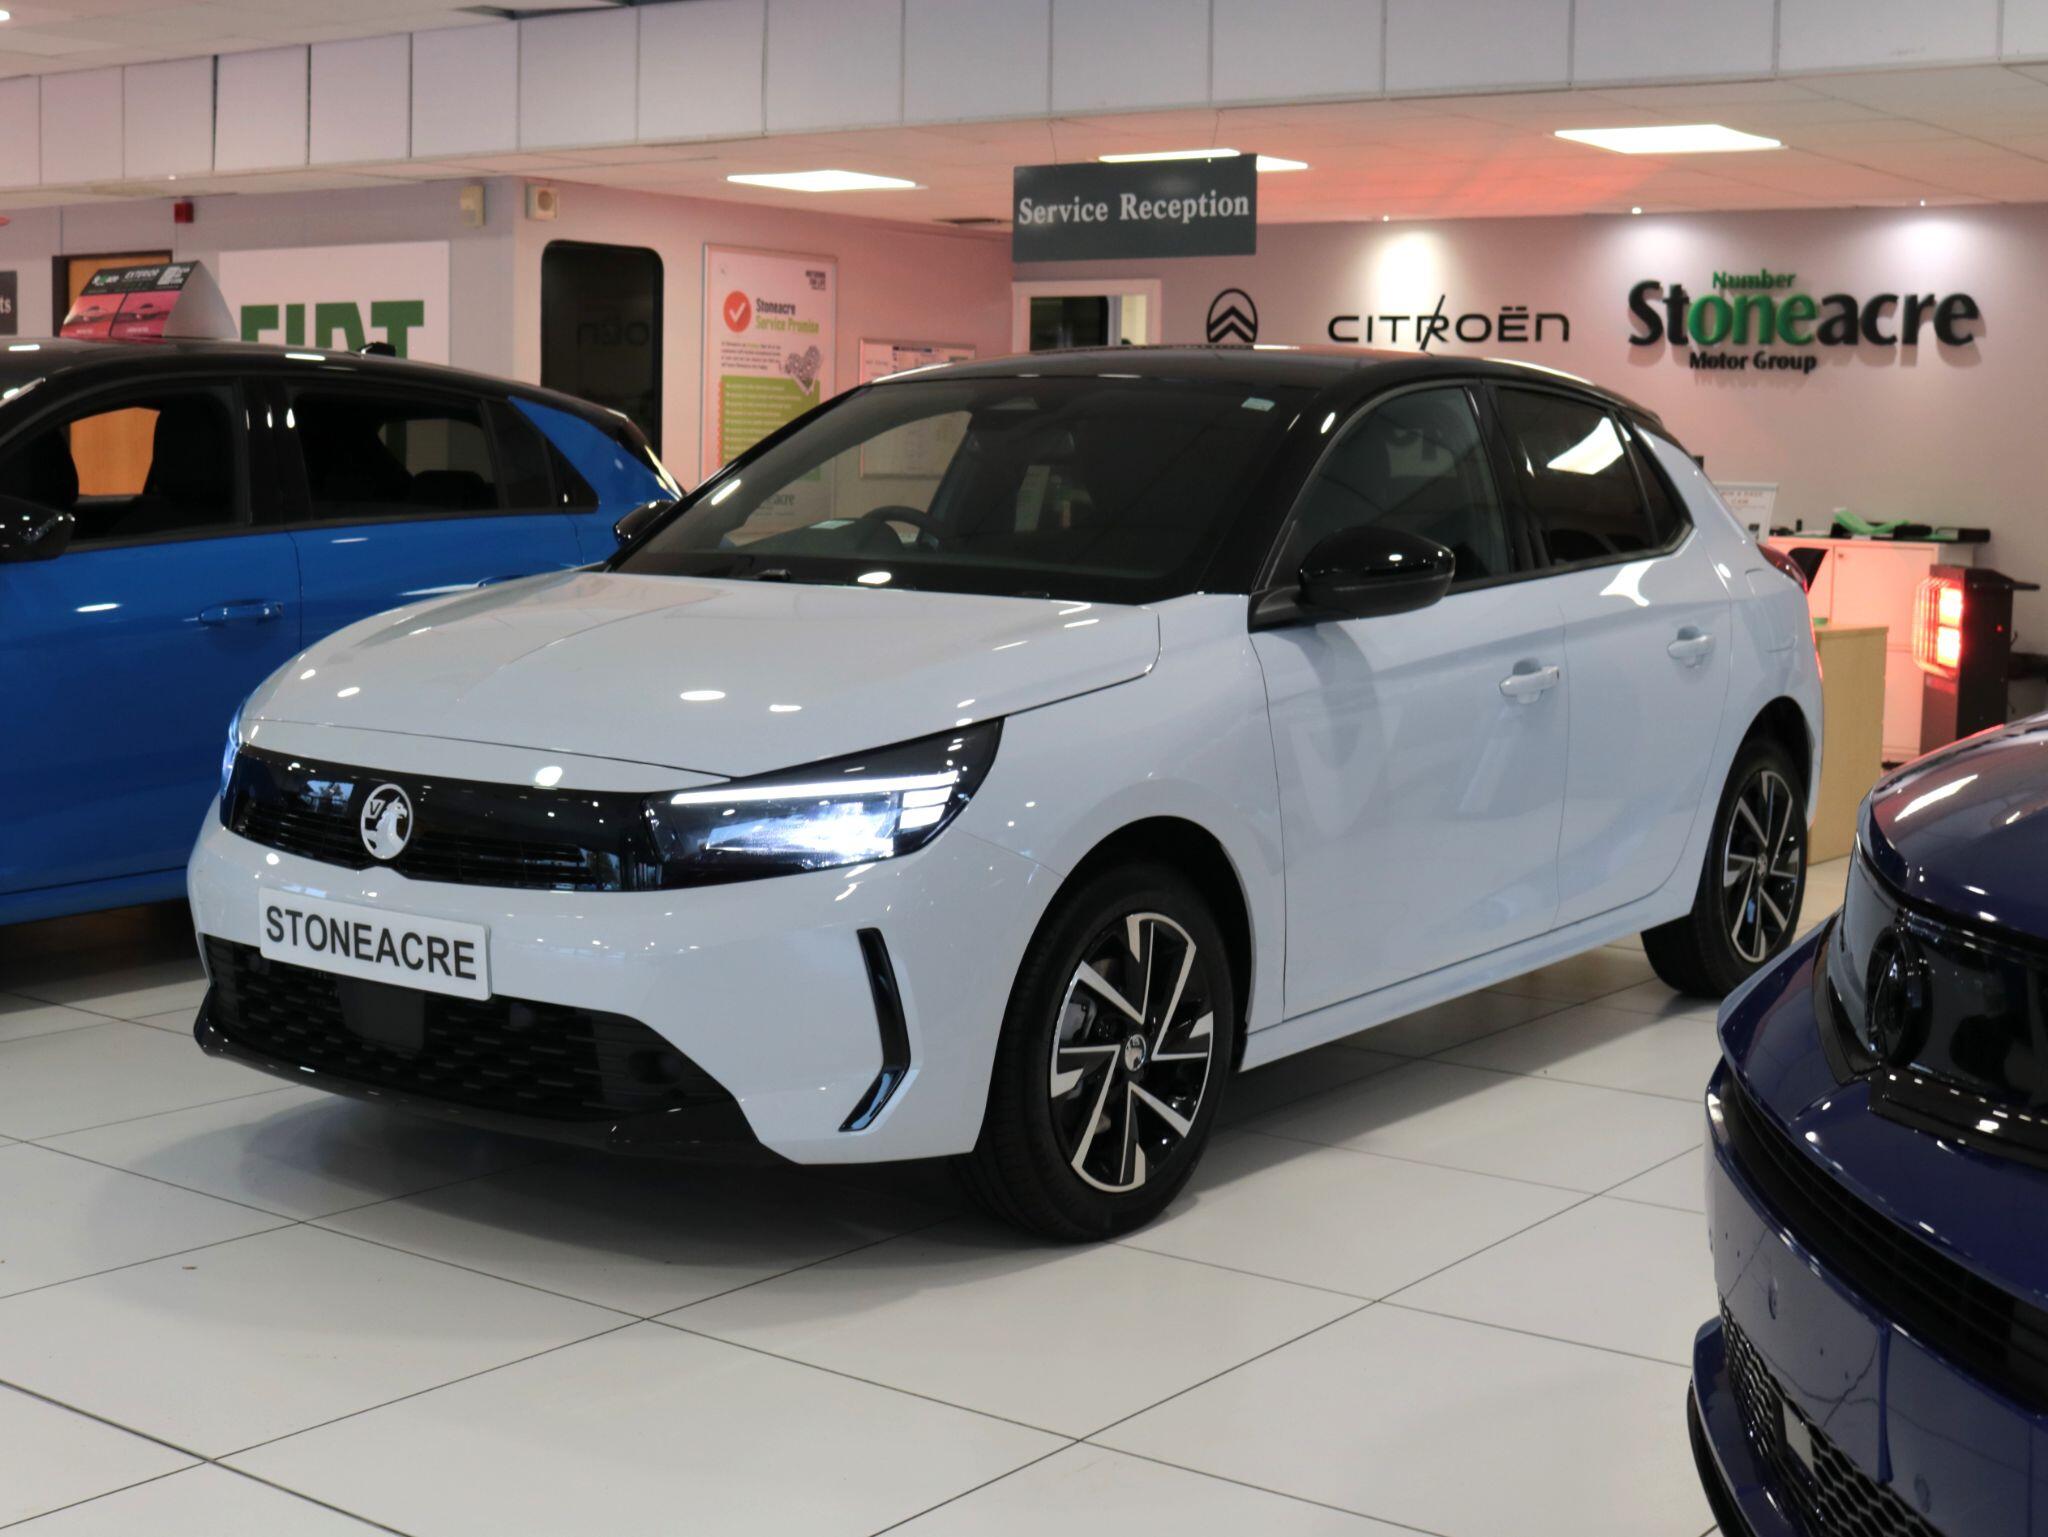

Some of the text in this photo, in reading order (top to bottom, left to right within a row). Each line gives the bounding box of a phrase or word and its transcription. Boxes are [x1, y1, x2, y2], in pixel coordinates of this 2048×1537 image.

[1018, 190, 1250, 225] Service Reception
[1712, 269, 1797, 291] Number
[756, 297, 796, 316] Stoneacre
[1628, 279, 1980, 347] Stoneacre
[756, 314, 819, 335] Service Promise
[1689, 352, 1818, 375] Motor Group
[266, 905, 477, 981] STONEACRE
